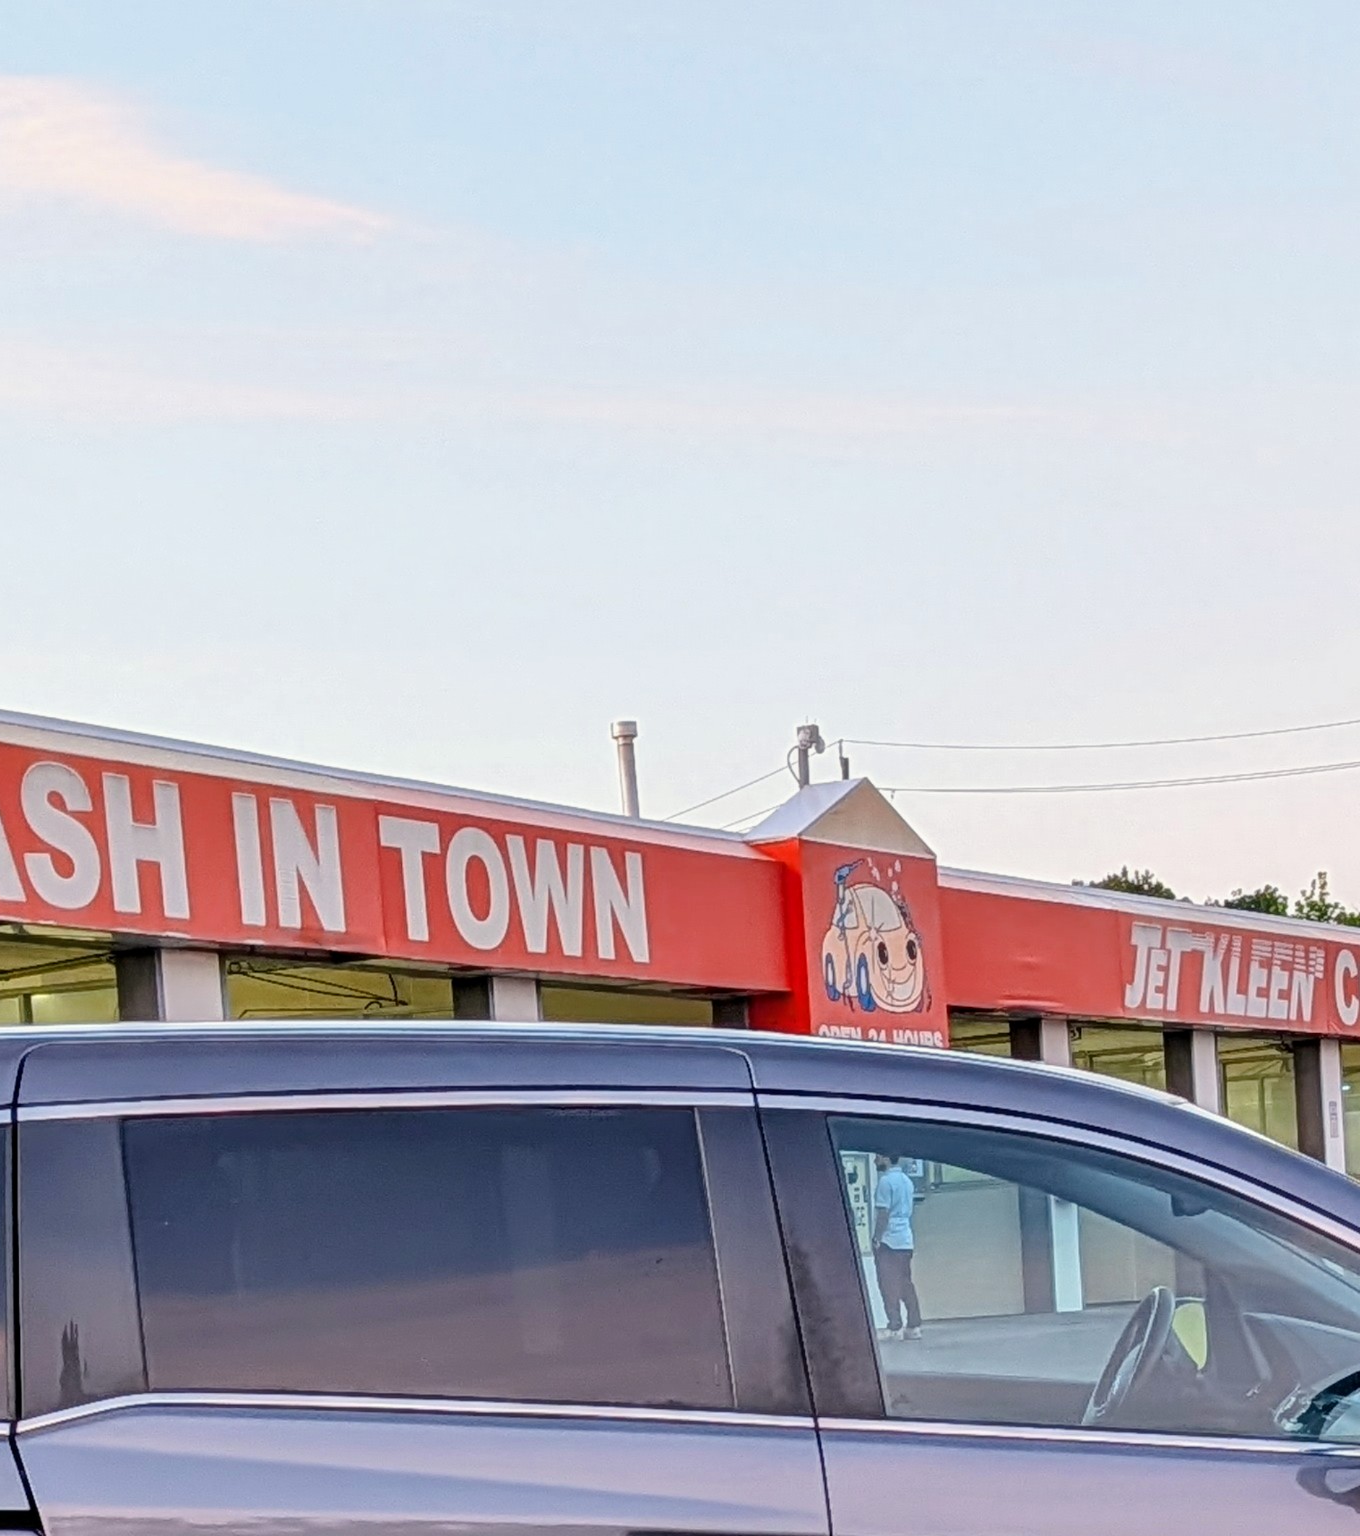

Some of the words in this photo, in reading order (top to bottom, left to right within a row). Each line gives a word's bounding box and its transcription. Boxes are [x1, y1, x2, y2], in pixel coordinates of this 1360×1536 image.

[231, 792, 346, 933] IN
[377, 813, 650, 963] TOWN
[1124, 922, 1191, 1011] JET
[1190, 931, 1325, 1022] KLEEN
